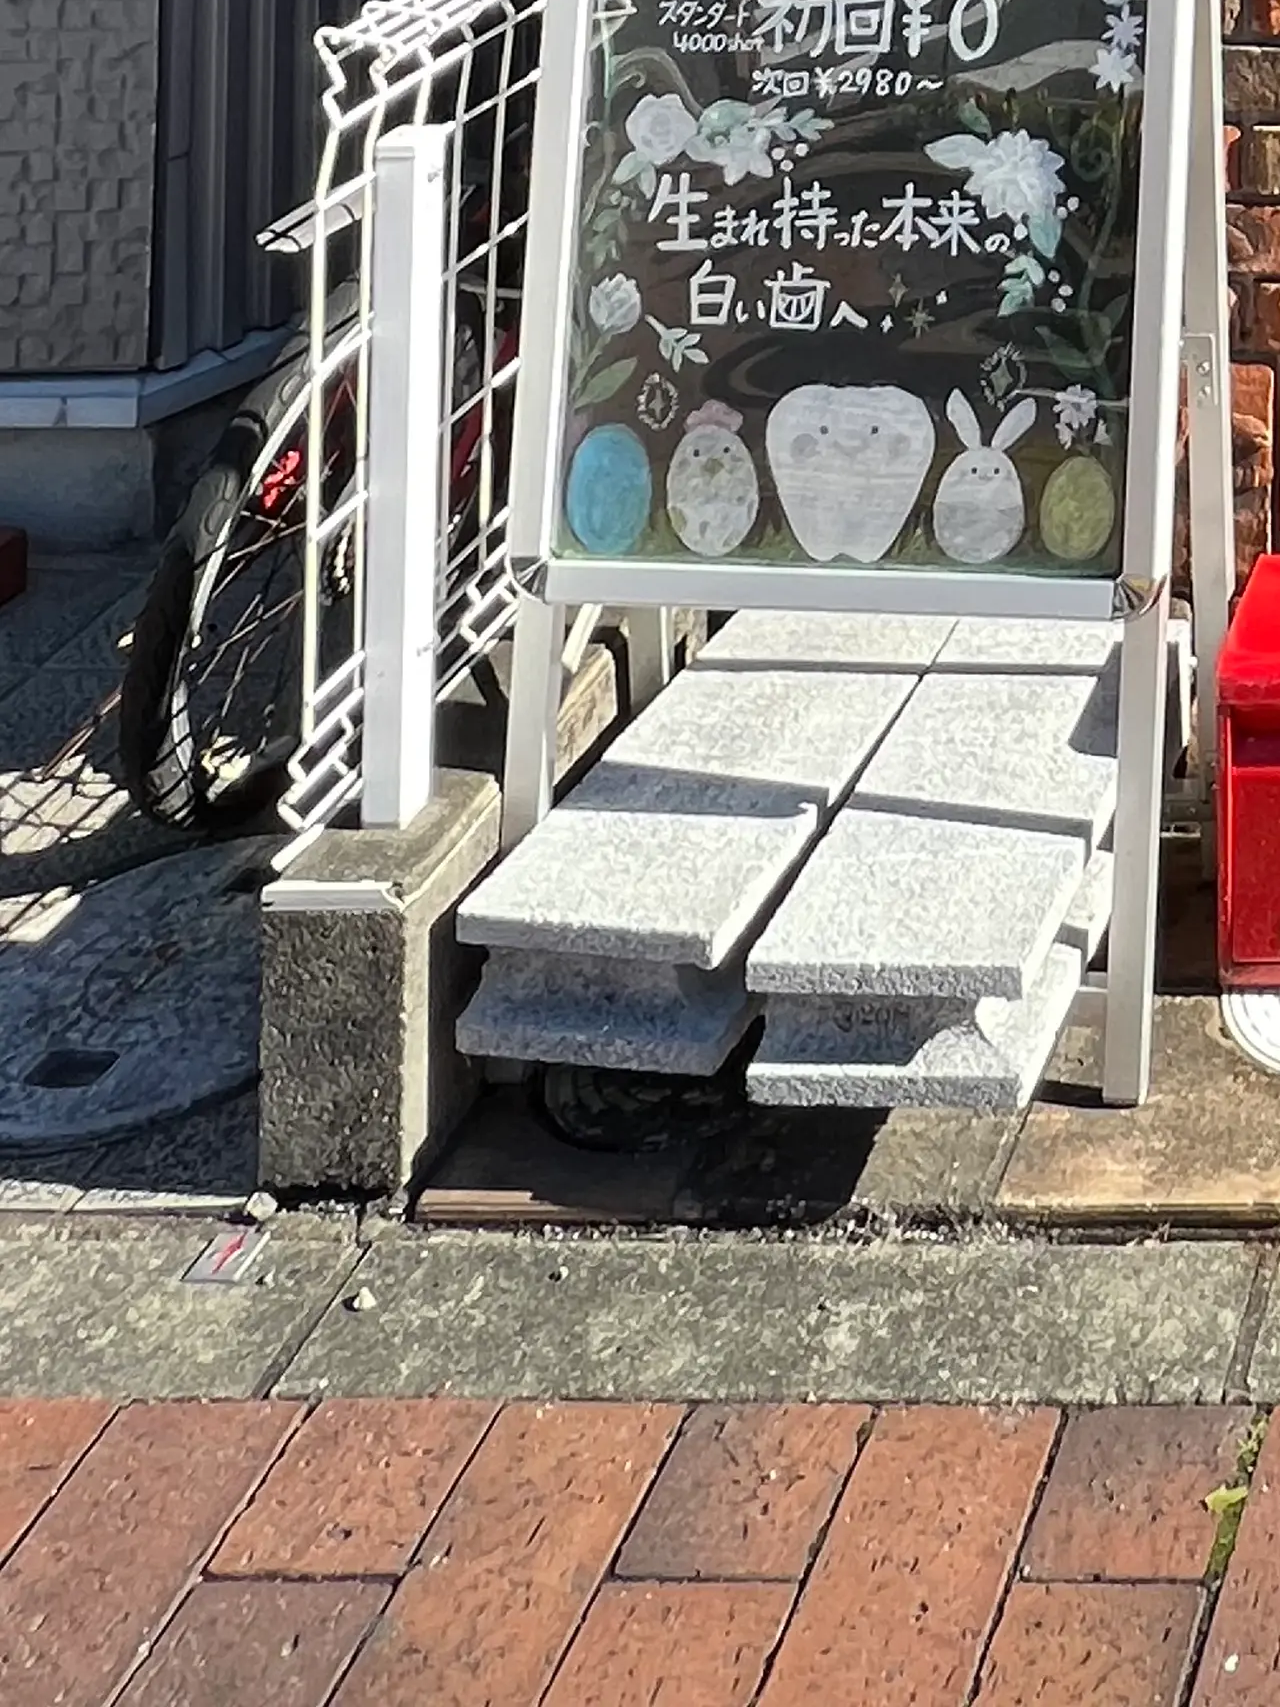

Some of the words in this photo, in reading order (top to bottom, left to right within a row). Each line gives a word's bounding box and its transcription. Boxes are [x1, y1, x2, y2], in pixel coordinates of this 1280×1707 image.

[649, 173, 1010, 255] 生まれ持った本来の
[688, 258, 868, 331] 白い歯へ
